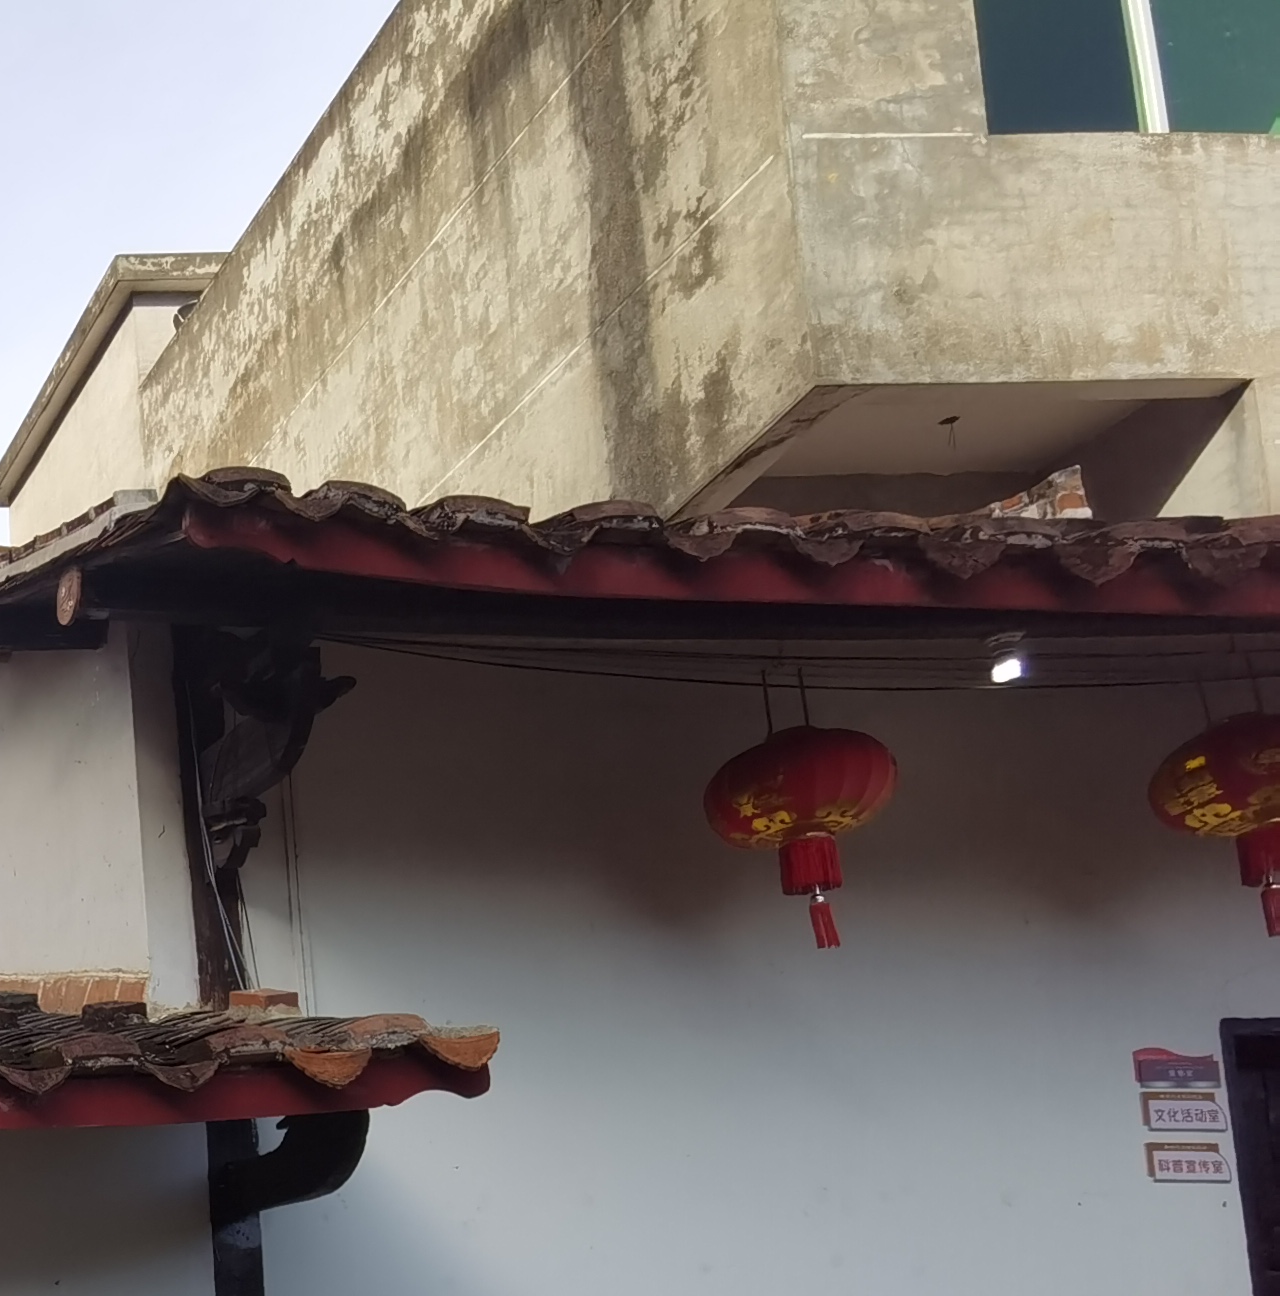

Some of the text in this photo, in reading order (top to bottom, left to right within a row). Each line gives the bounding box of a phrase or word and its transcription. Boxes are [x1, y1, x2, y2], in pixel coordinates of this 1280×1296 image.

[1153, 1108, 1220, 1123] 文化活动室
